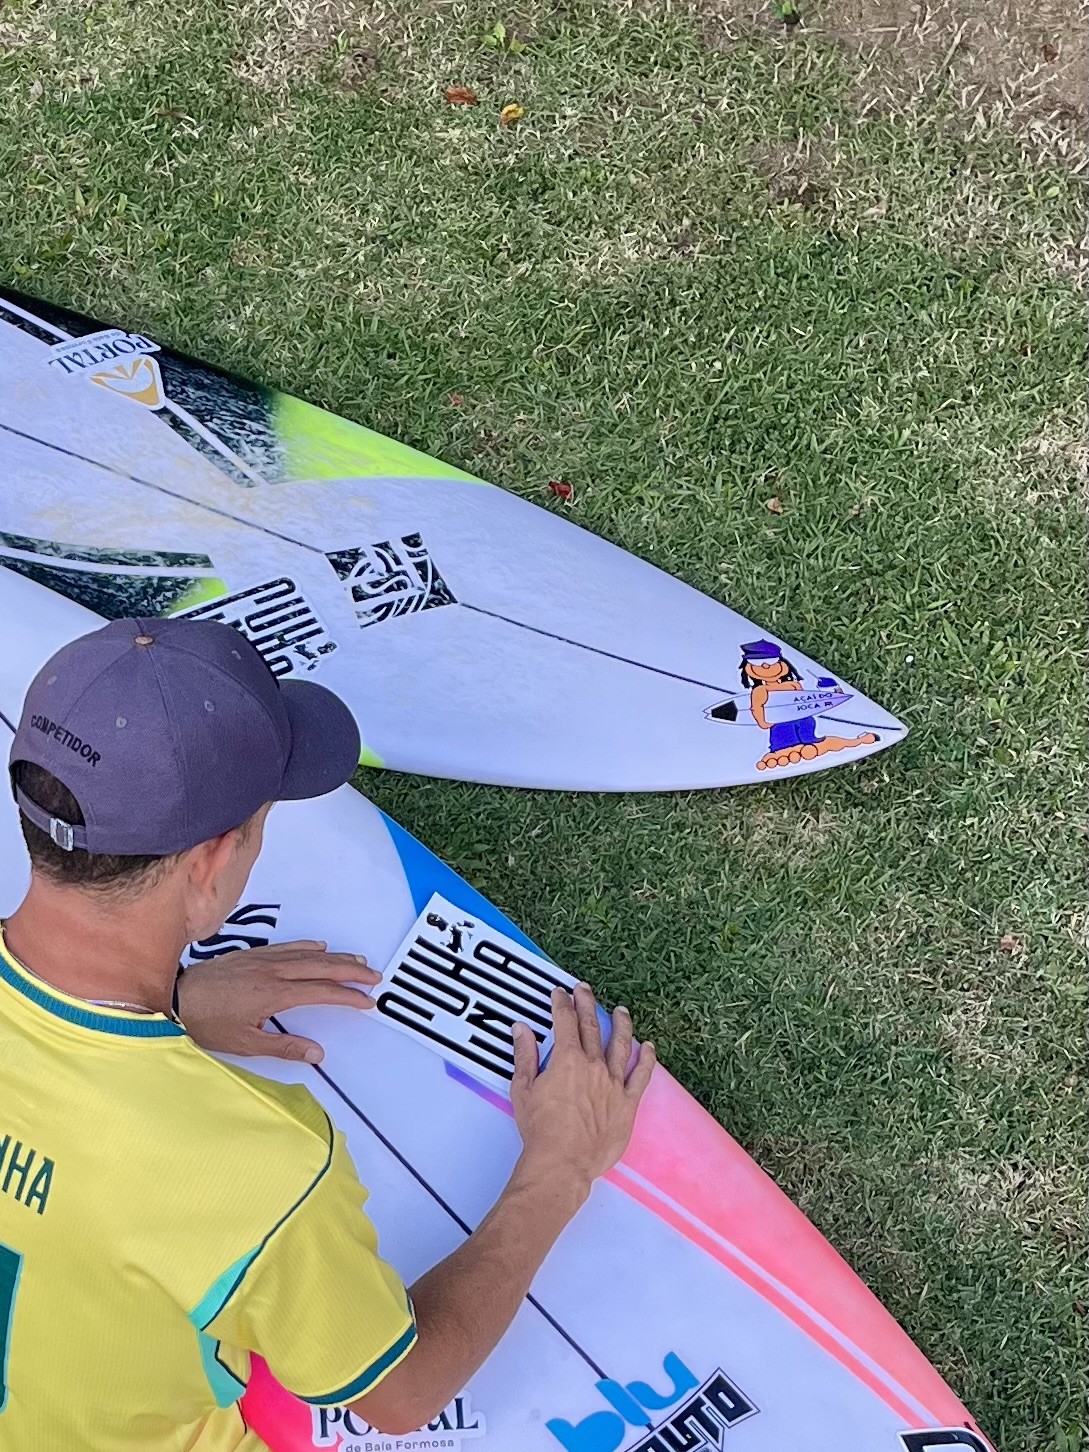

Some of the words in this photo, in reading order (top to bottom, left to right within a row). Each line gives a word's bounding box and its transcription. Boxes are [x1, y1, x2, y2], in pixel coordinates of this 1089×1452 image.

[48, 337, 153, 373] PORTAL
[30, 714, 101, 768] COMPETIDOR
[346, 1443, 361, 1452] de
[396, 1438, 454, 1451] Formosa
